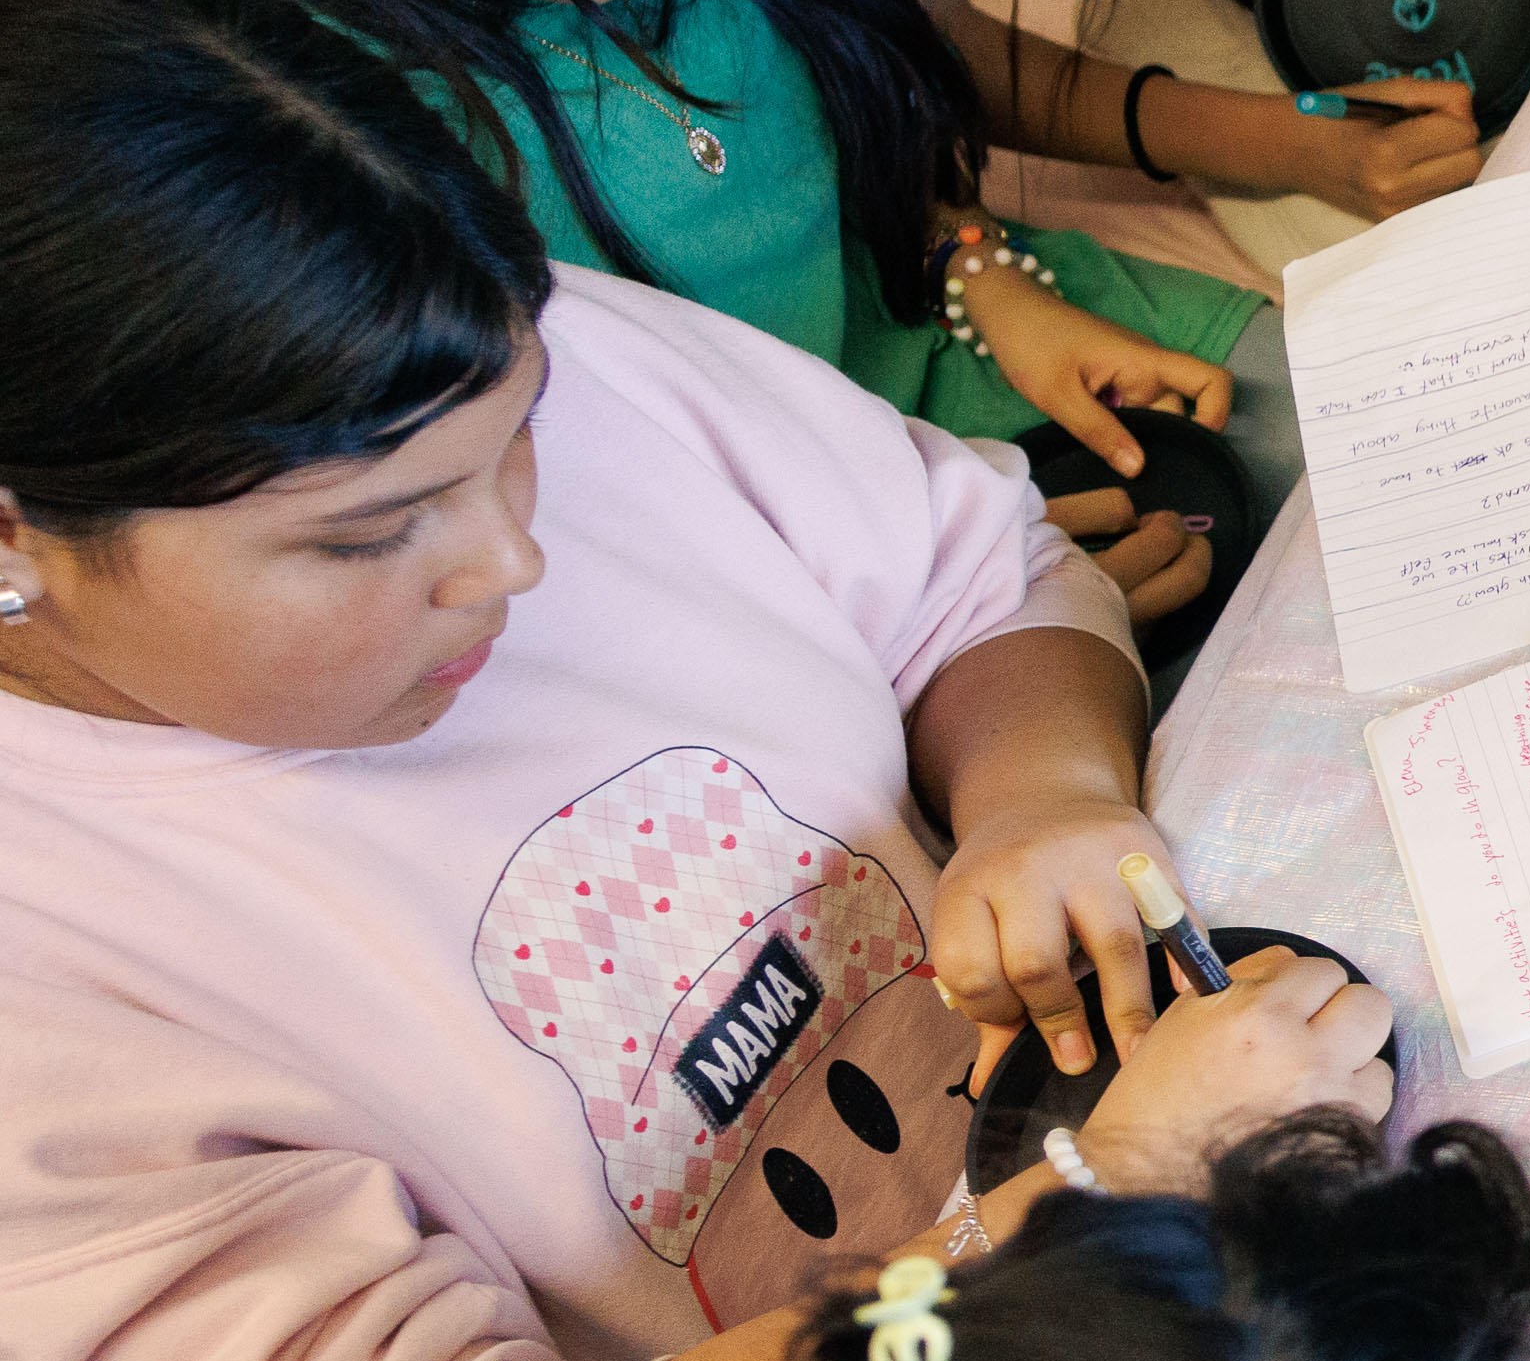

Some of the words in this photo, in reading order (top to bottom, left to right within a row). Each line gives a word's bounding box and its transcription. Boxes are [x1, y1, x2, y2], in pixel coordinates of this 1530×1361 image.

[1415, 417, 1455, 433] thing
[1352, 433, 1399, 455] about
[1494, 442, 1512, 457] ok
[1425, 467, 1441, 476] to
[1441, 548, 1465, 559] we
[1447, 560, 1478, 574] like
[1411, 571, 1434, 586] we
[1519, 574, 1530, 583] in
[1487, 874, 1501, 885] do
[695, 964, 807, 1105] MAMA
